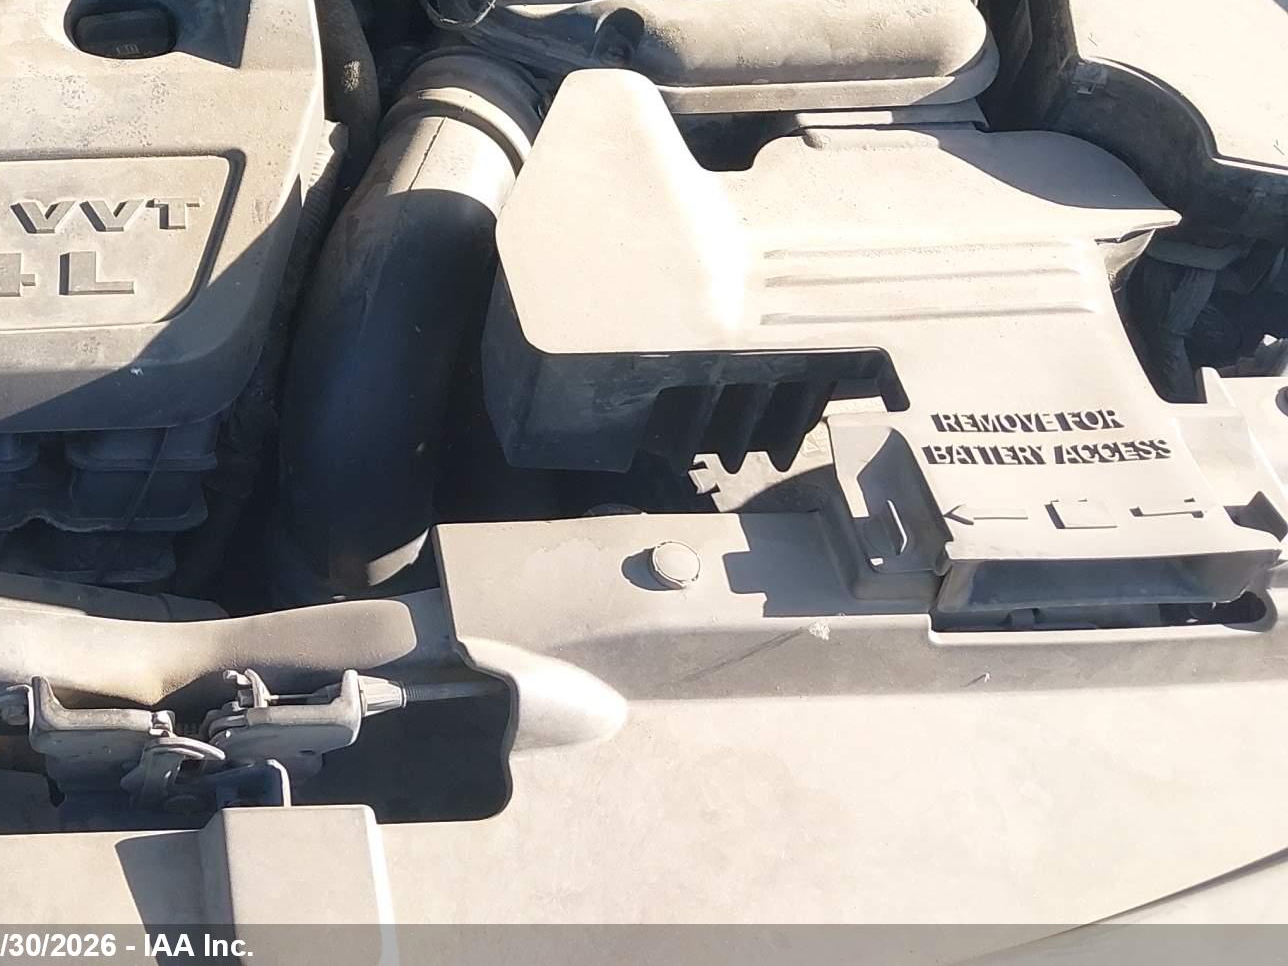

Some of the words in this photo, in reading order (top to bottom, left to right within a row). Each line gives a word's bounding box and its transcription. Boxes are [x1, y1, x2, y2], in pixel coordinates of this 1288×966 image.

[10, 197, 202, 234] VVT
[930, 411, 1054, 433] REMOVE
[1054, 409, 1125, 431] FOR
[921, 444, 1047, 465] BATTERY
[1054, 439, 1173, 464] ACCESS
